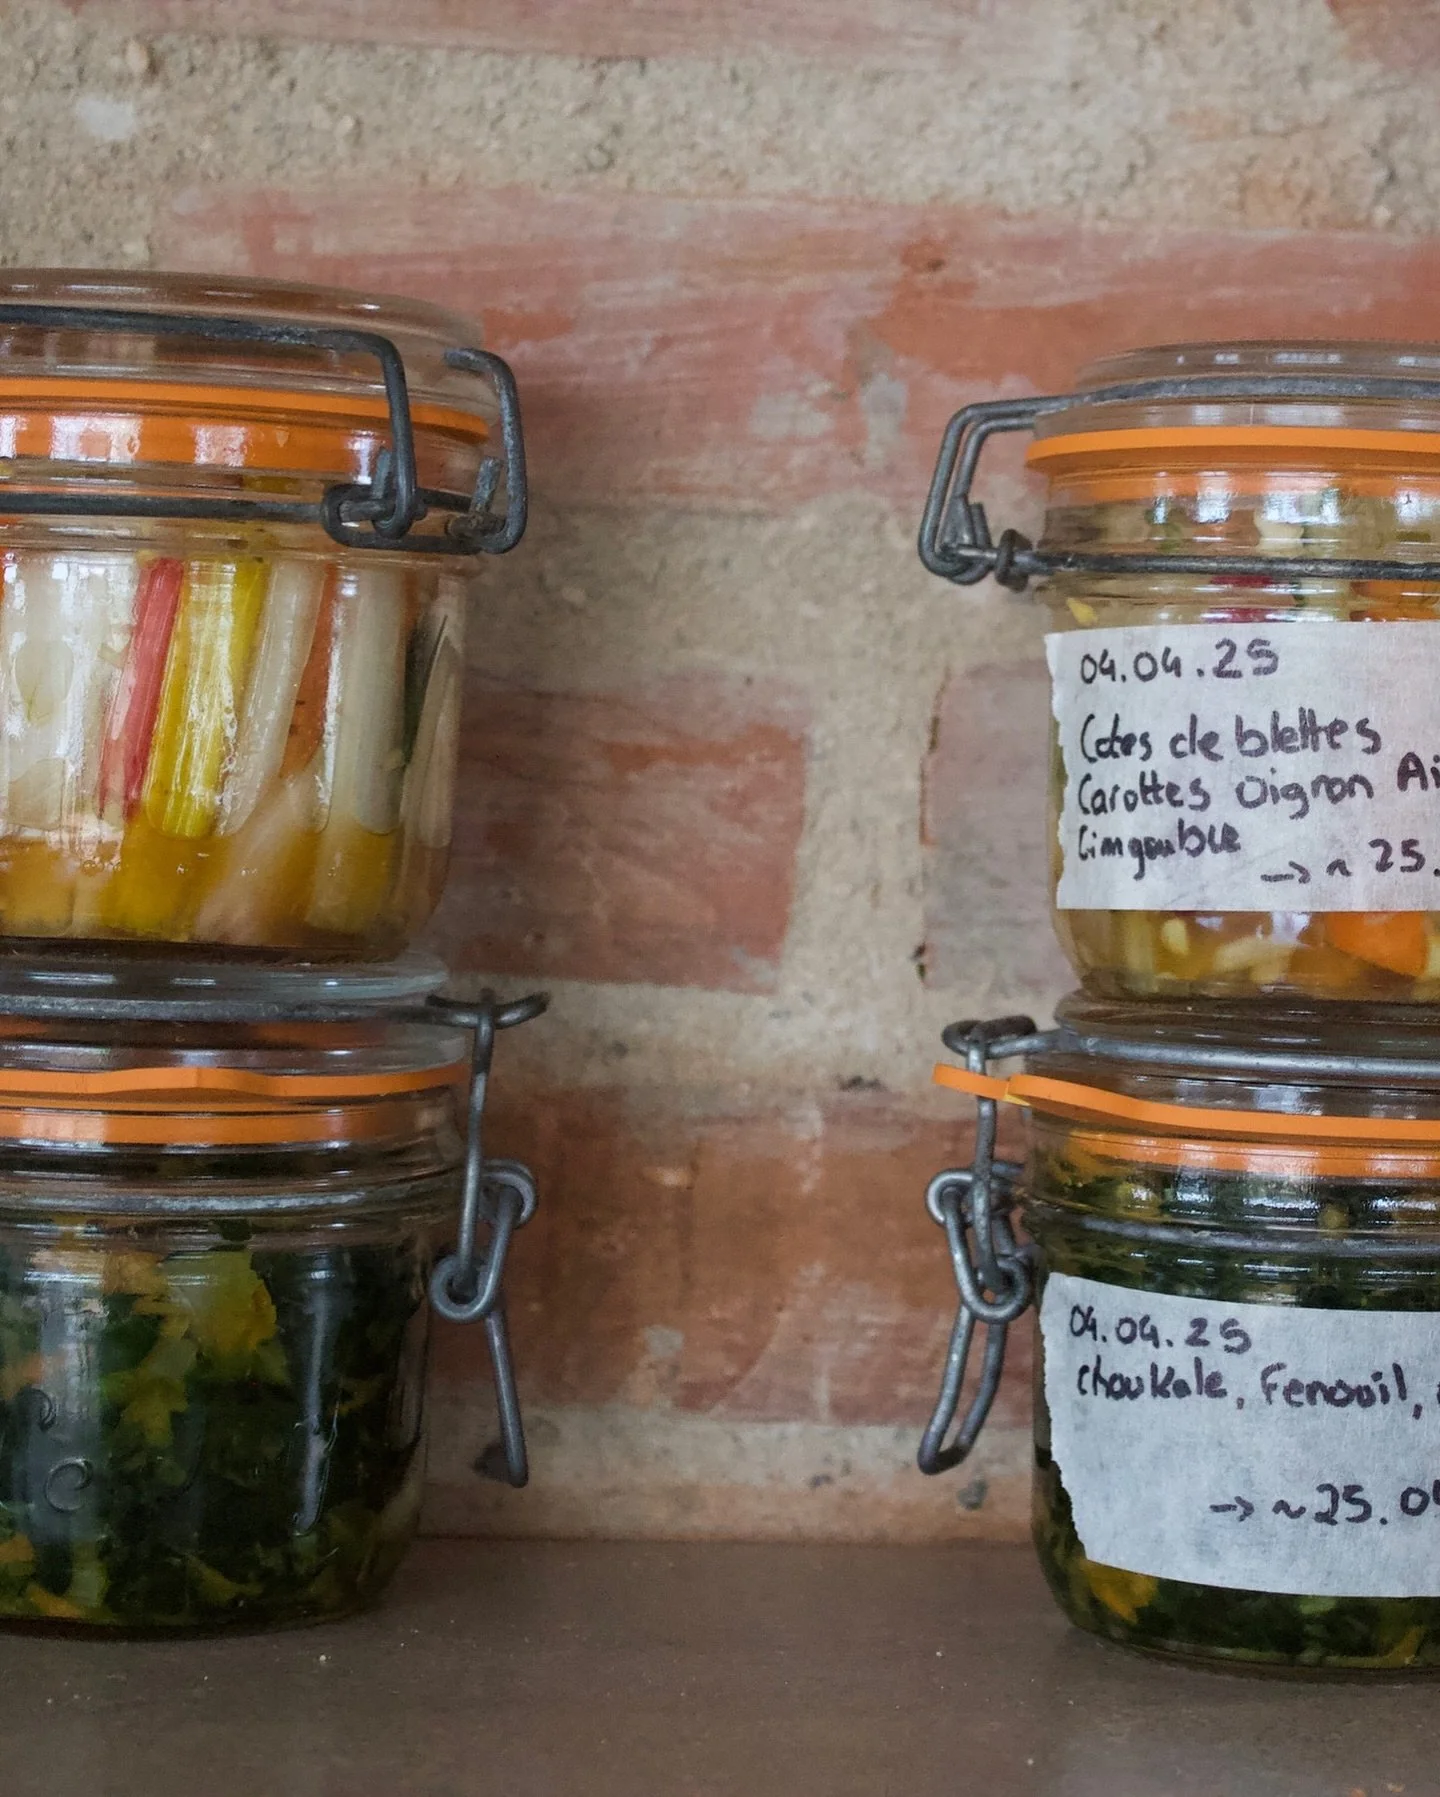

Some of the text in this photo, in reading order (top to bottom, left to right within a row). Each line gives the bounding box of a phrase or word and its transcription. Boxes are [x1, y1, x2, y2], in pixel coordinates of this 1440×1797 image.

[1080, 638, 1280, 684] 04.04.25
[1169, 713, 1224, 762] de
[1235, 706, 1382, 757] blettes
[1077, 771, 1211, 817] Carottes
[1235, 767, 1374, 820] Oignon
[1068, 1304, 1252, 1355] 04.04.25
